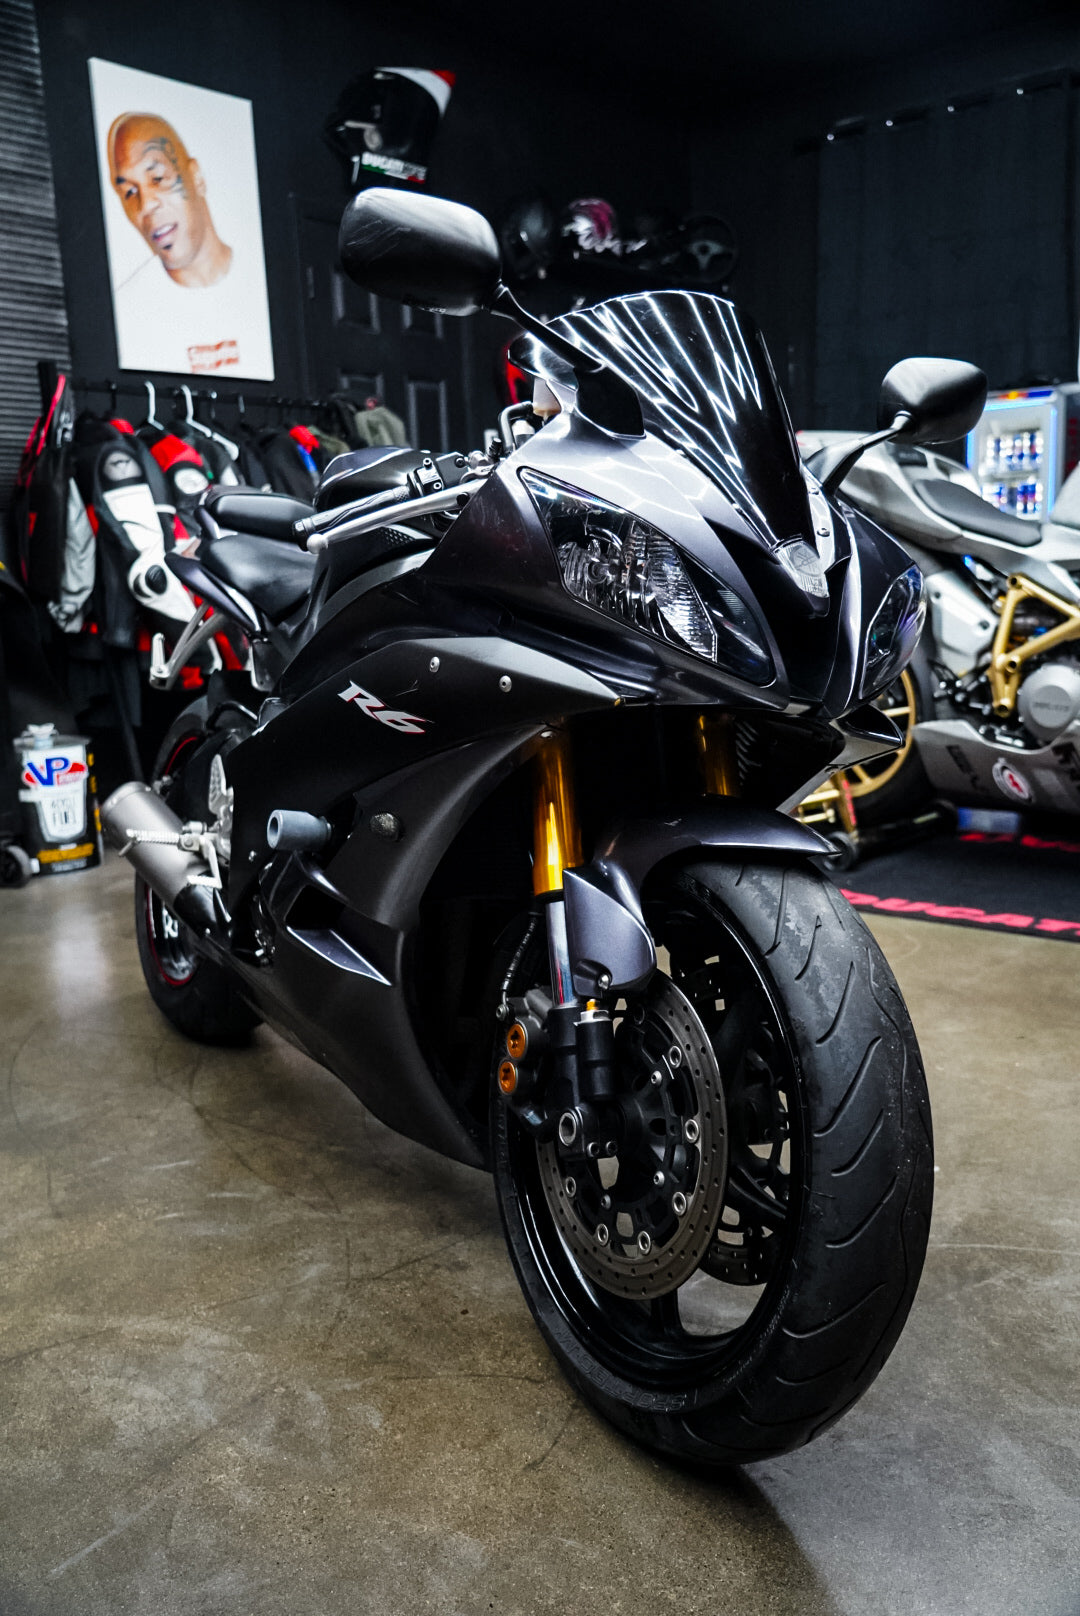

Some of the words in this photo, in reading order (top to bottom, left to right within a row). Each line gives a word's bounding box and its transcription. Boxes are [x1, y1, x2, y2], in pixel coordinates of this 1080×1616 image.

[337, 680, 426, 734] R6
[27, 756, 70, 786] VP
[840, 888, 1080, 937] DUCAT
